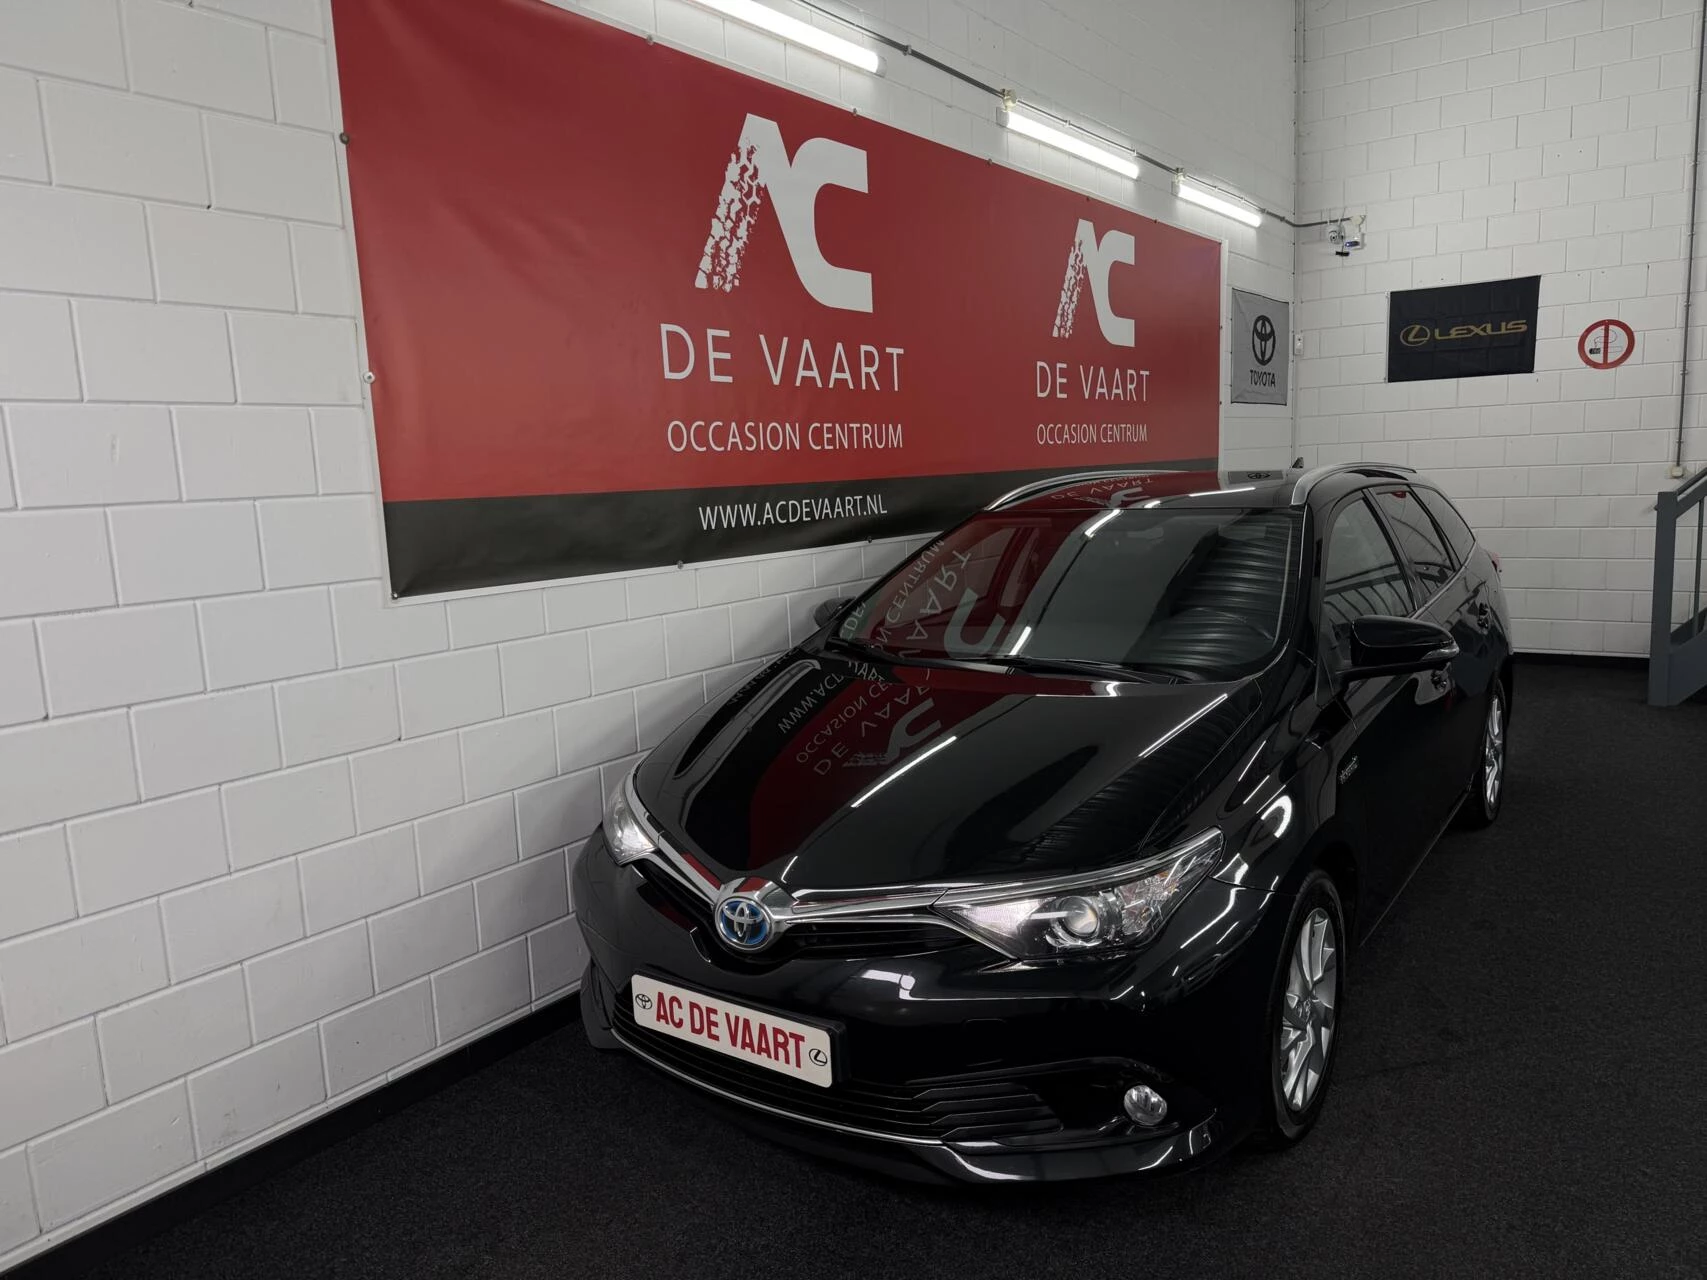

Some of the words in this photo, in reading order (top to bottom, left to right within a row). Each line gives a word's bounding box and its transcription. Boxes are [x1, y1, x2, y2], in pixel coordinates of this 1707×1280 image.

[695, 113, 873, 313] AC
[1052, 218, 1135, 347] AC
[1434, 319, 1528, 340] LEXUS
[660, 323, 733, 383] DE
[759, 334, 904, 391] VAART
[1036, 361, 1068, 399] DE
[1079, 365, 1150, 401] VAART
[1249, 369, 1276, 388] TOYOTA
[667, 420, 800, 452] OCCASION
[808, 422, 903, 450] CENTRUM
[1036, 424, 1097, 445] OCCASION
[1100, 424, 1147, 443] CENTRUM
[699, 494, 887, 530] WWW.ACDEVAART.NL
[656, 991, 684, 1030] AC
[689, 1001, 720, 1042] DE
[725, 1012, 805, 1070] VAART
